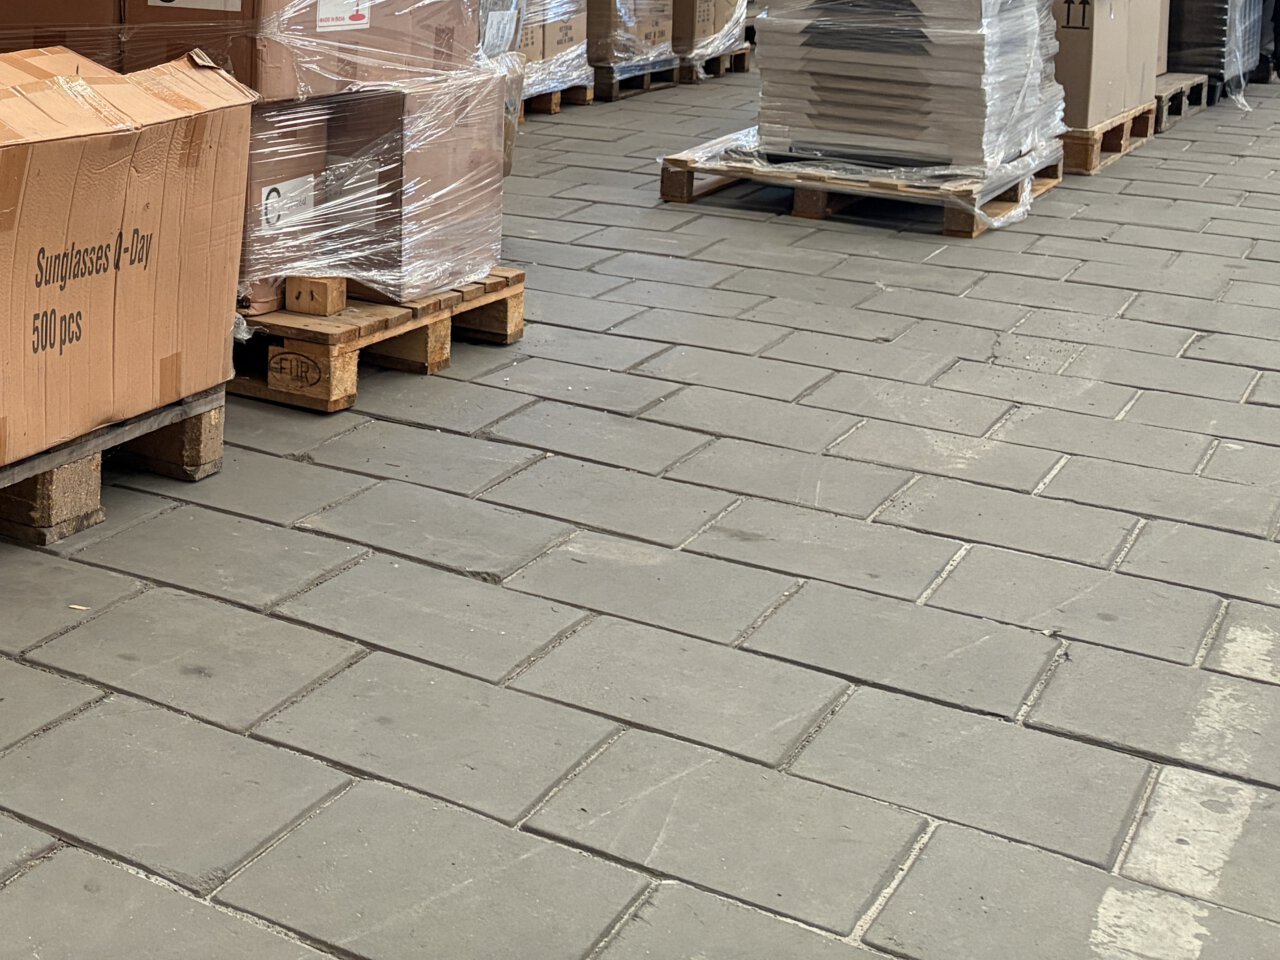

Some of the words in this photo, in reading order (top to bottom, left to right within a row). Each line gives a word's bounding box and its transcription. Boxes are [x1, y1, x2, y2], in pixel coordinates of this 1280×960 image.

[34, 241, 110, 291] Sunglasses
[112, 227, 153, 273] Q-Day
[32, 308, 56, 354] 500
[59, 309, 83, 357] pcs
